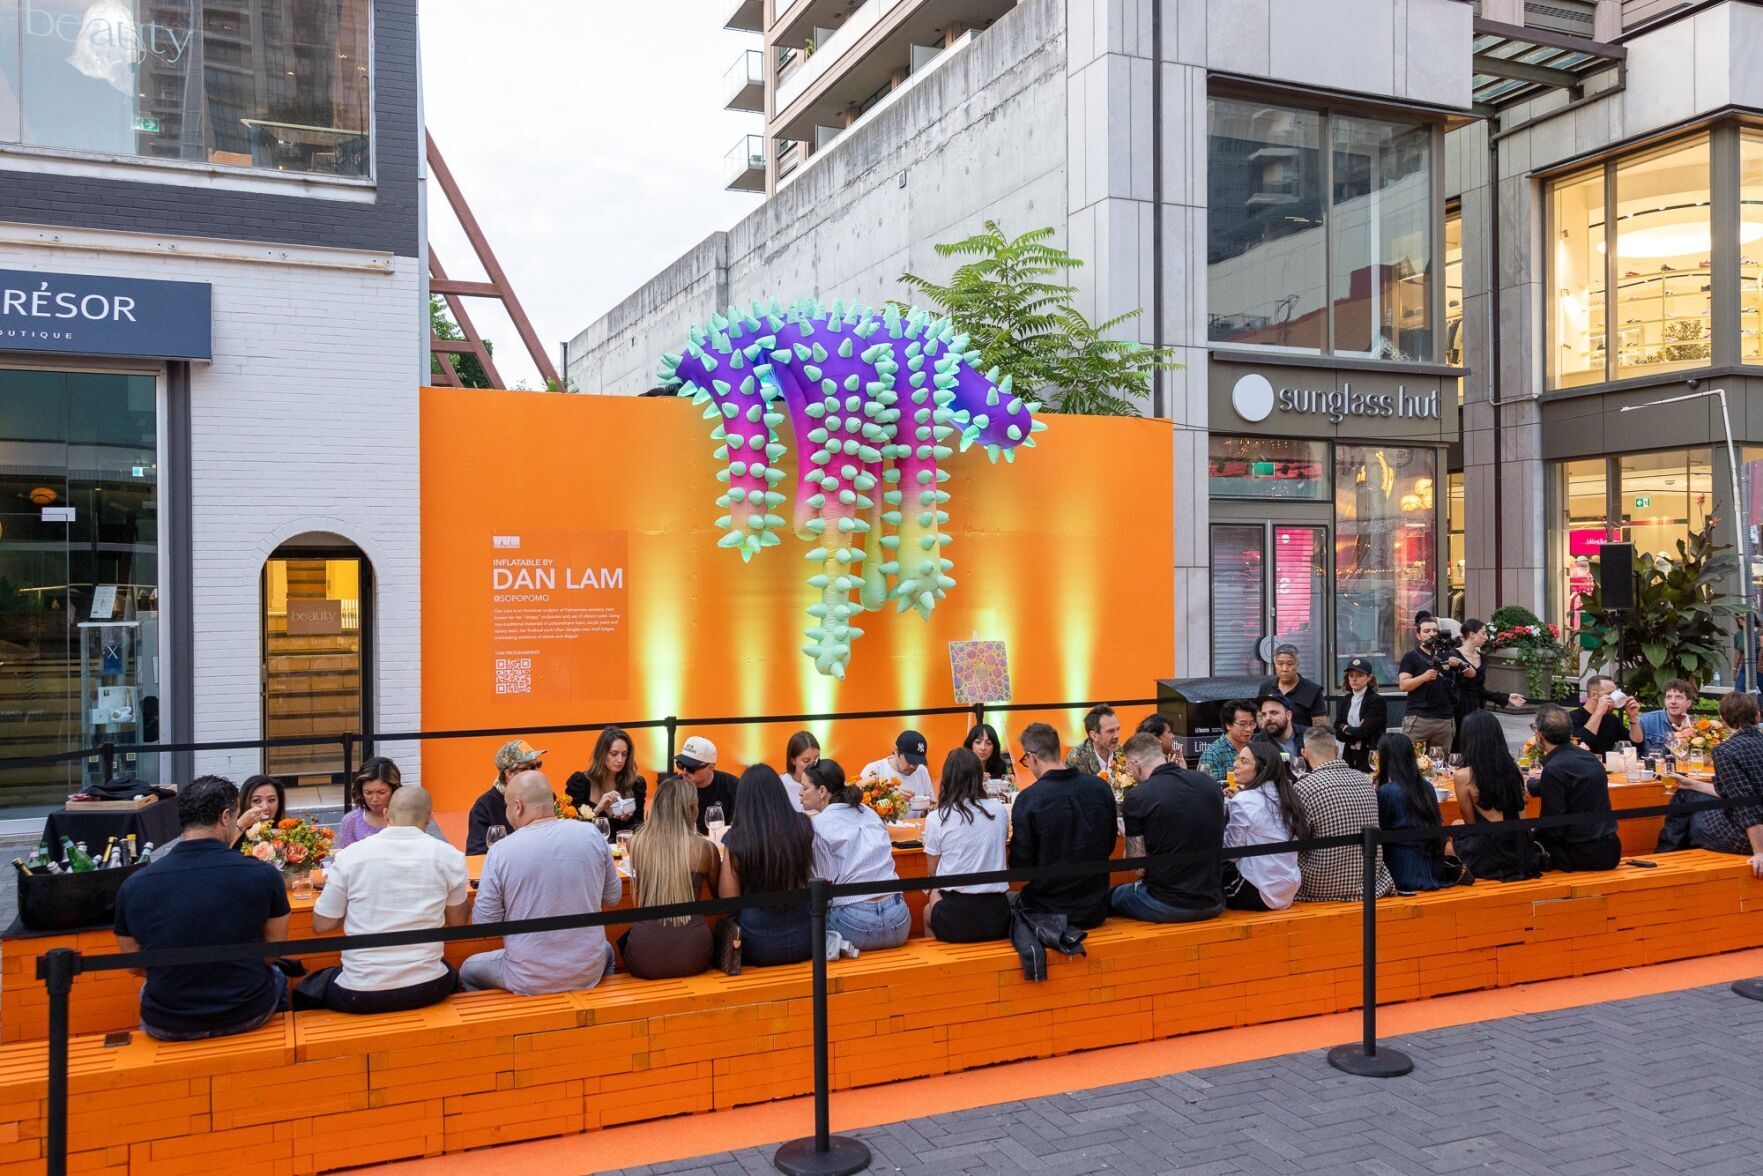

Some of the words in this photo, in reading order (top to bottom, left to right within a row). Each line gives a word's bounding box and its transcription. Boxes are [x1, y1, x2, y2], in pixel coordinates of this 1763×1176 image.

[26, 0, 194, 63] beauty
[1279, 383, 1393, 424] sunglass
[1399, 385, 1441, 419] hut
[493, 568, 556, 590] DAN
[566, 568, 623, 589] LAM
[494, 594, 550, 603] @SOPOPOMO
[291, 610, 336, 623] beauty
